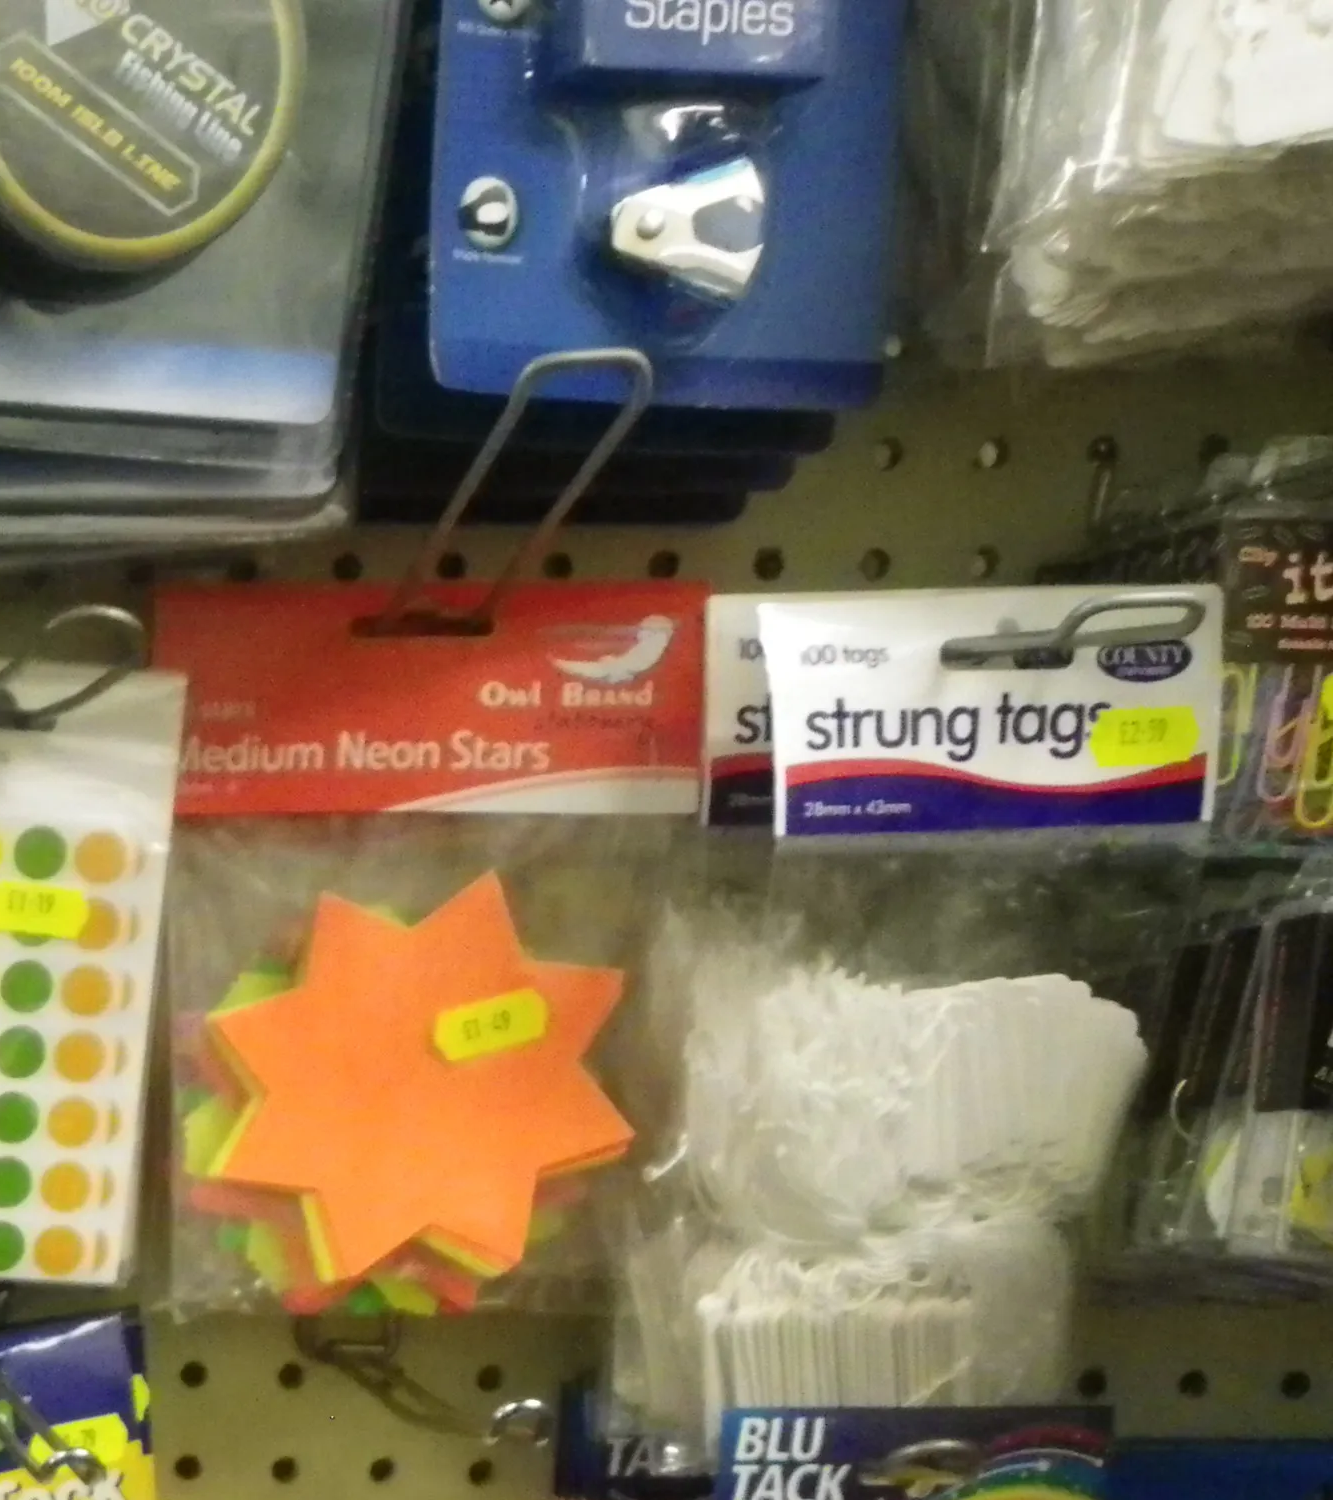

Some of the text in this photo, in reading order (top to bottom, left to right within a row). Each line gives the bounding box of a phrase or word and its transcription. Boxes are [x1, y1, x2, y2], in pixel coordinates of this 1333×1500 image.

[624, 0, 795, 46] Staples
[121, 13, 261, 136] CRYSTAL
[843, 644, 890, 668] tags
[1099, 645, 1185, 664] COUNTY
[478, 680, 654, 708] Owl Brand
[179, 729, 551, 773] Medium Neon Stars
[806, 698, 980, 762] strung
[735, 1416, 826, 1463] BLU
